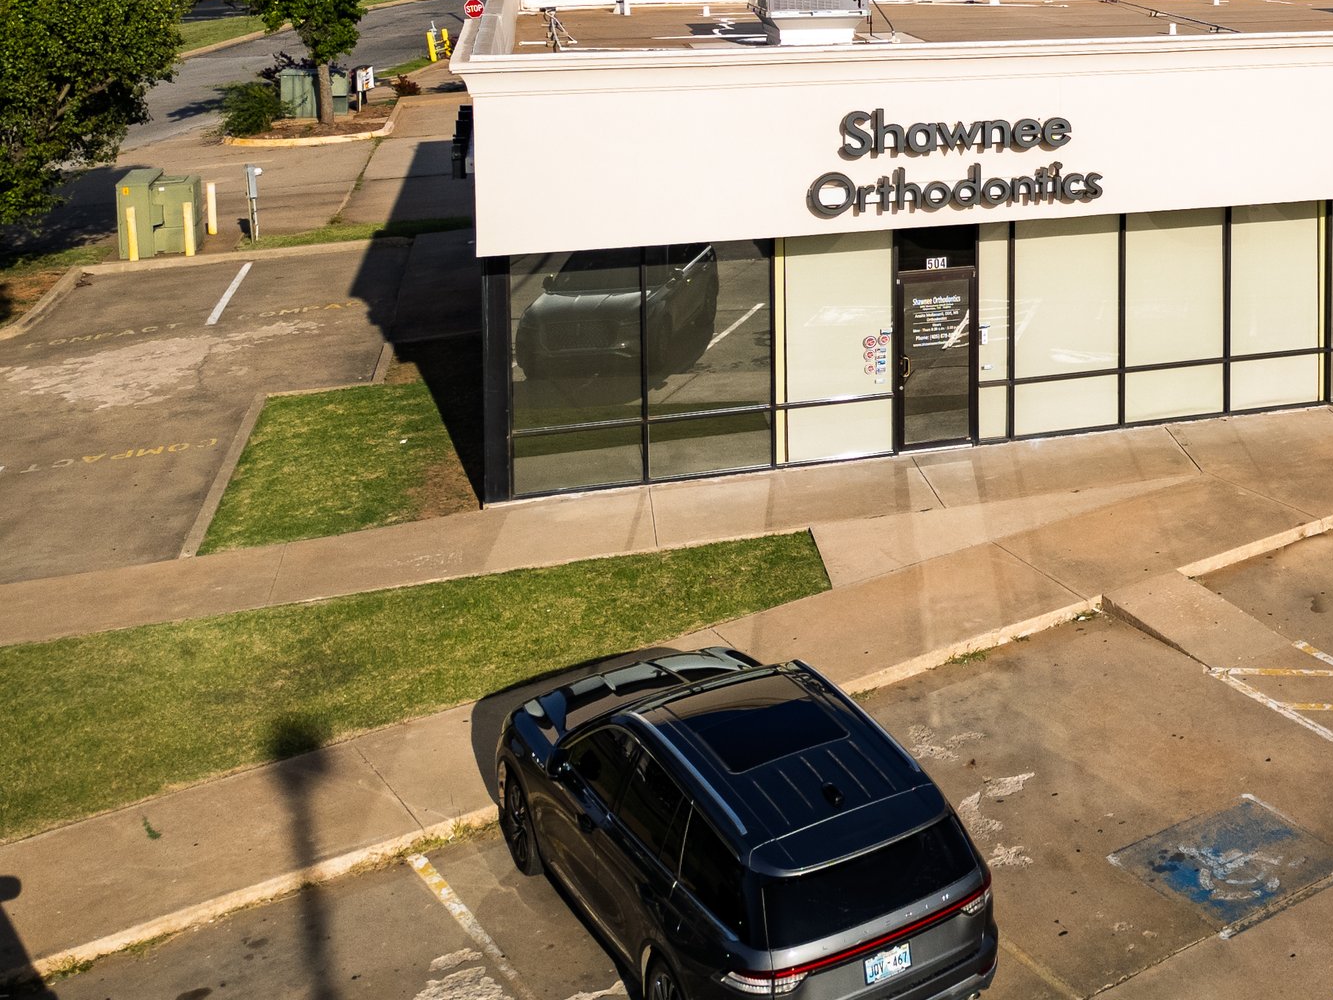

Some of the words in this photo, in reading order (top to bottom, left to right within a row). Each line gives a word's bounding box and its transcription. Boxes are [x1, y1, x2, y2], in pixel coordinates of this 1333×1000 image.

[466, 4, 482, 13] STOP
[840, 108, 1072, 159] Shawnee
[807, 161, 1103, 218] Orthodontics
[927, 258, 946, 270] 504
[237, 300, 362, 320] COMPAC
[24, 321, 185, 349] COMPACT
